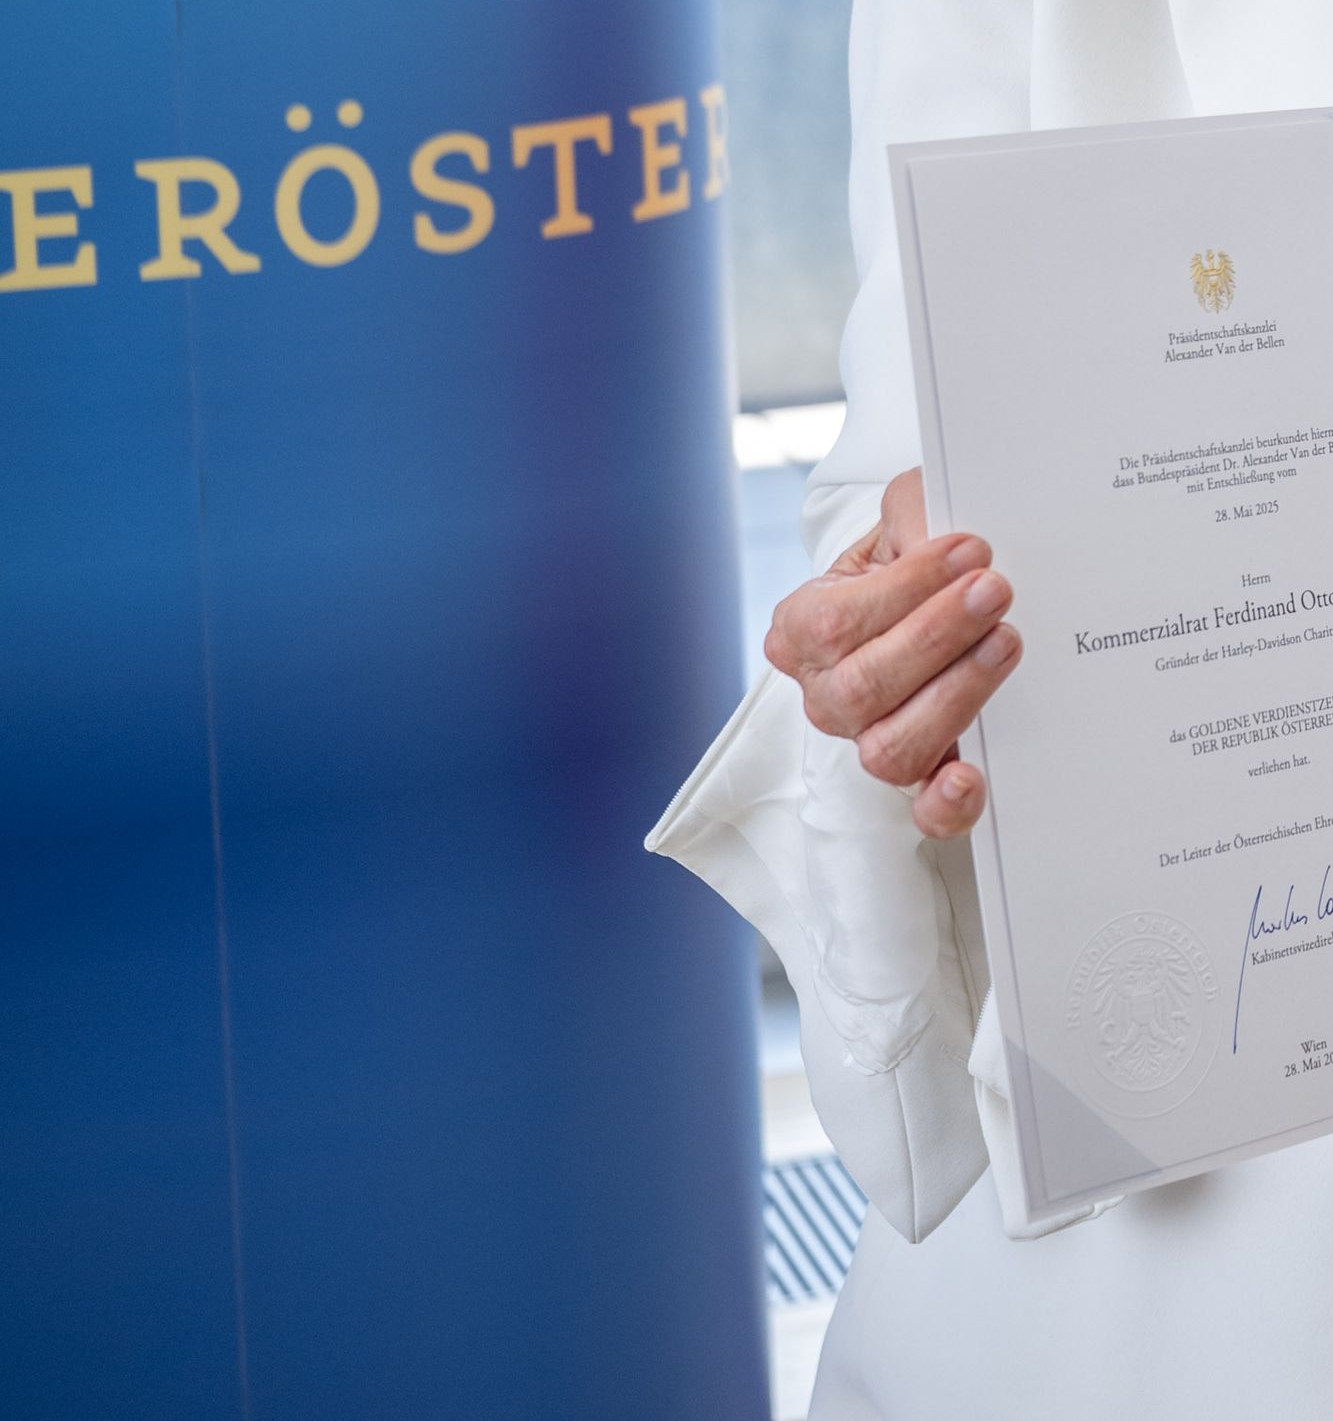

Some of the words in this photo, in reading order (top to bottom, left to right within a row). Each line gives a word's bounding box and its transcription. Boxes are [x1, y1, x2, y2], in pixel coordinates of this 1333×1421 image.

[1168, 319, 1278, 346] Präsidentschaftskanzlei
[1164, 344, 1214, 364] Alexander
[1214, 341, 1237, 355] Van
[1237, 338, 1255, 353] der
[1255, 335, 1286, 351] Bellen
[1119, 456, 1140, 471] Die
[1141, 438, 1255, 468] Präsidentschaftskanzlei
[1255, 431, 1310, 453] beurkundet
[1112, 475, 1135, 489] dass
[1136, 461, 1222, 485] Bundespräsident
[1222, 457, 1241, 476] Dr.
[1239, 450, 1290, 475] Alexander
[1289, 447, 1310, 460] Van
[1311, 444, 1328, 457] der
[1186, 480, 1205, 494] mit
[1206, 470, 1277, 491] Entschließung
[1275, 467, 1298, 479] vom
[1214, 508, 1232, 523] 28.
[1232, 504, 1254, 520] Mai
[1254, 499, 1280, 516] 2025
[1241, 573, 1272, 588] Herrn
[1074, 612, 1209, 655] Kommerzialrat
[1213, 591, 1298, 629] Ferdinand
[1154, 651, 1201, 672] Gründer
[1202, 647, 1220, 663] der
[1221, 632, 1303, 660] Harley-Davidson
[1169, 729, 1187, 744] das
[1188, 714, 1252, 739] GOLDENE
[1191, 738, 1220, 757] DER
[1220, 724, 1280, 750] REPUBLIK
[1247, 758, 1292, 778] verliehen
[1291, 753, 1311, 768] hat.
[1159, 853, 1180, 866] Der
[1181, 846, 1213, 861] Leiter
[1214, 839, 1231, 854] der
[1233, 821, 1313, 850] Österreichischen
[1300, 1039, 1328, 1055] Wien
[1284, 1062, 1301, 1079] 28.
[1301, 1055, 1322, 1073] Mai
